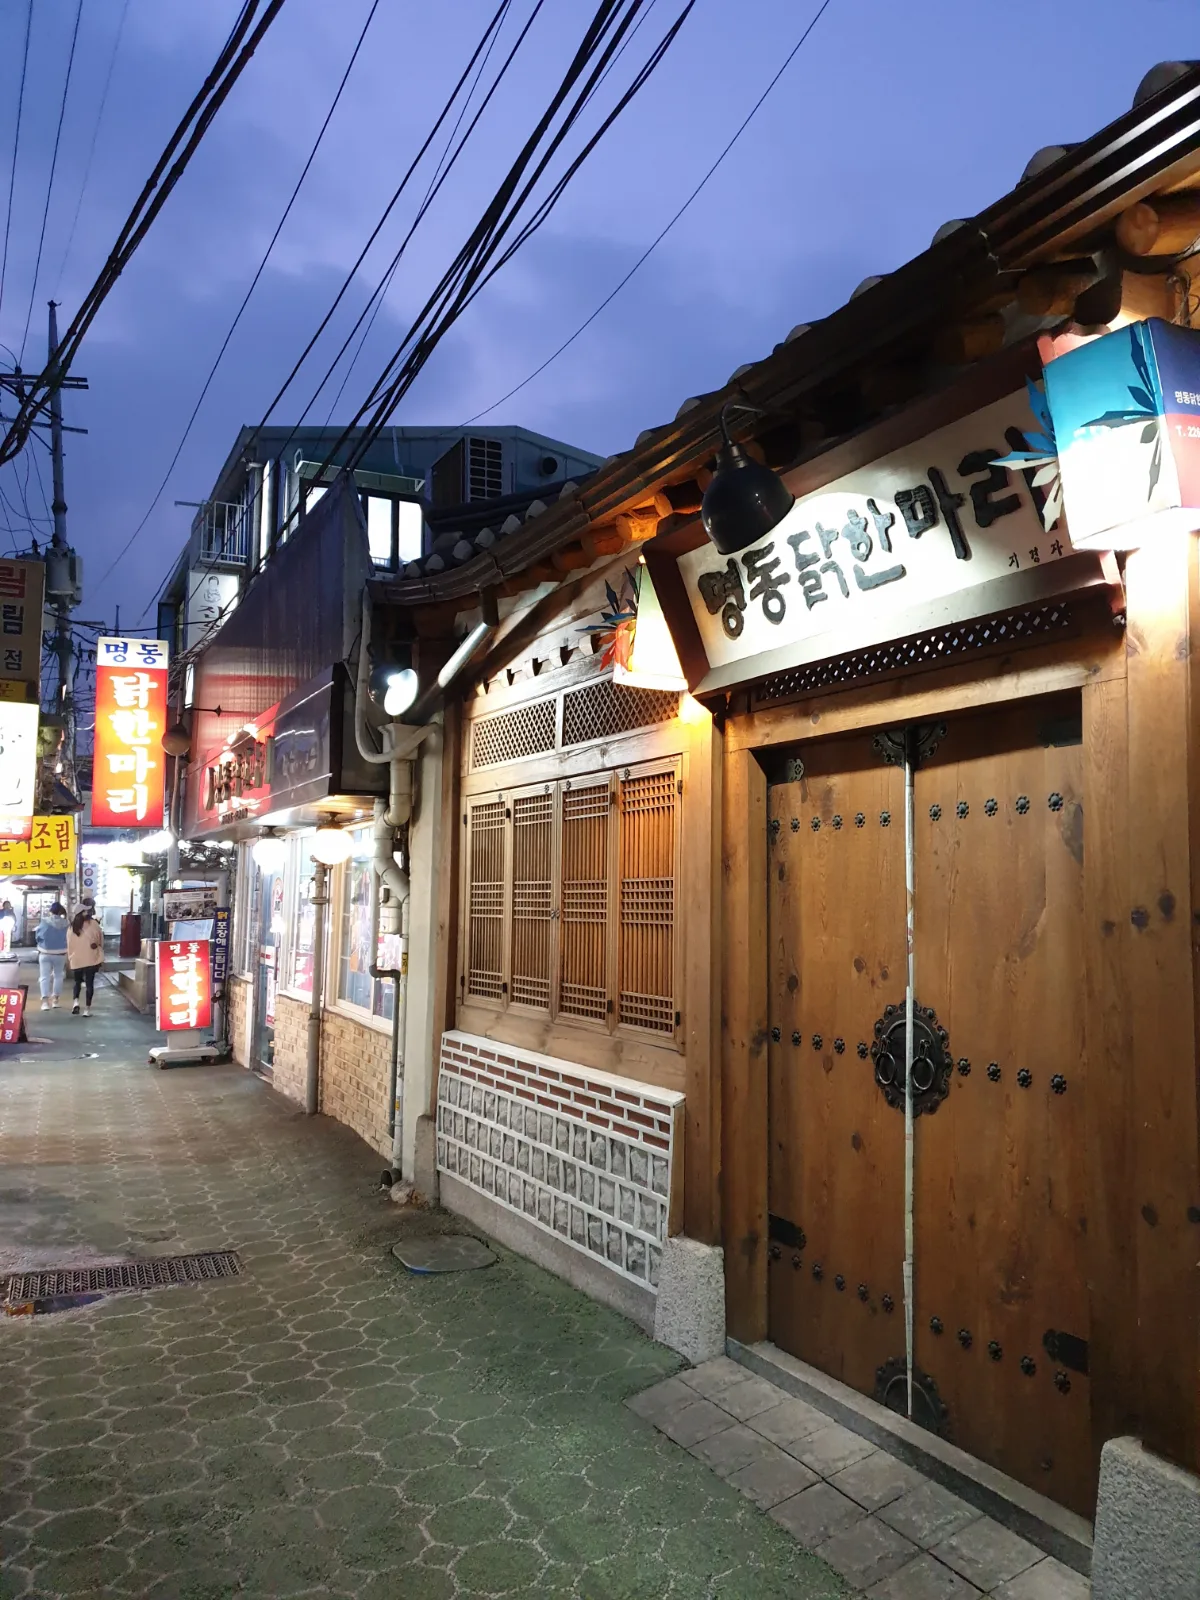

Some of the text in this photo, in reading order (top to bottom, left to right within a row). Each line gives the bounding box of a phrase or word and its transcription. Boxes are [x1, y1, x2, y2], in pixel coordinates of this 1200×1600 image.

[104, 641, 164, 664] 명동
[105, 672, 159, 821] 닭한마리
[168, 942, 200, 954] 명동
[214, 947, 227, 980] 드립니다
